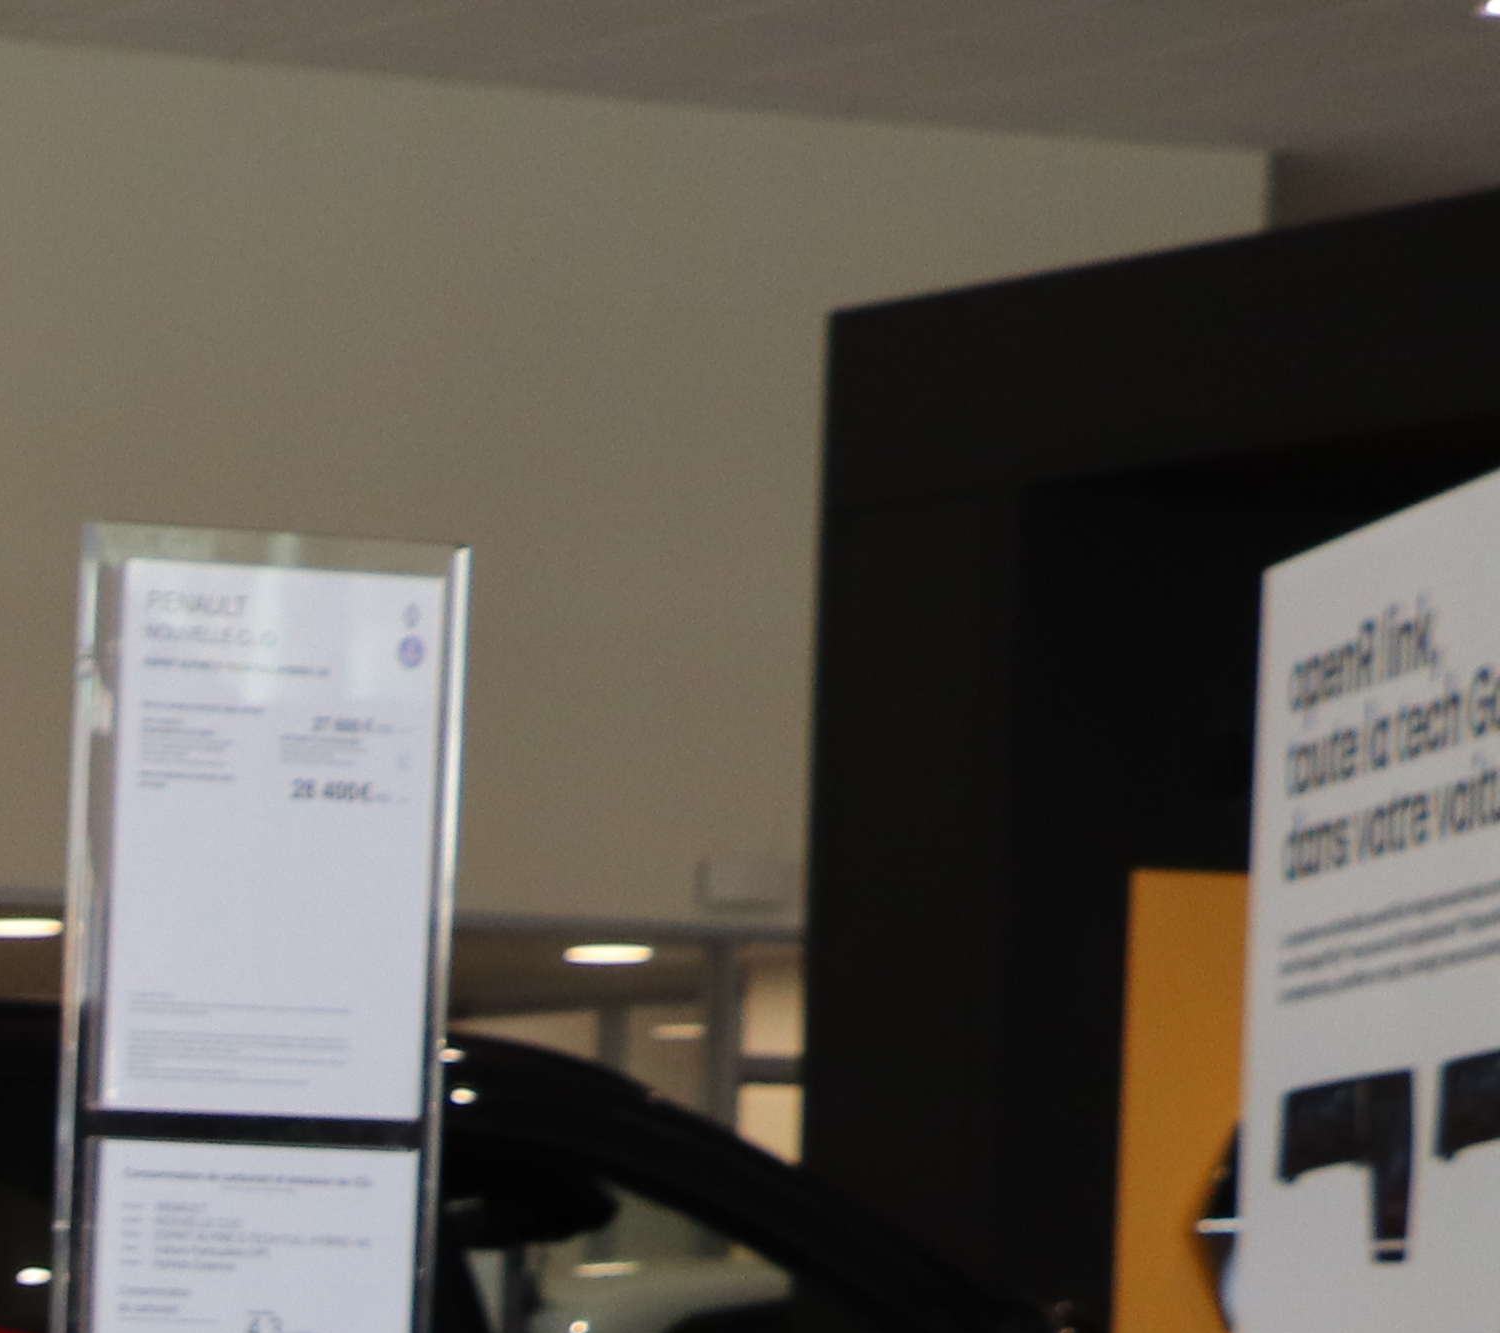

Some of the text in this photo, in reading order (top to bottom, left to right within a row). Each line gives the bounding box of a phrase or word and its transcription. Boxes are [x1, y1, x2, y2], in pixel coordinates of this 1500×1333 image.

[1287, 724, 1358, 797] toute
[1360, 696, 1391, 774] la
[1397, 672, 1462, 763] tech
[1283, 809, 1350, 881] dans
[1359, 790, 1429, 862] votre
